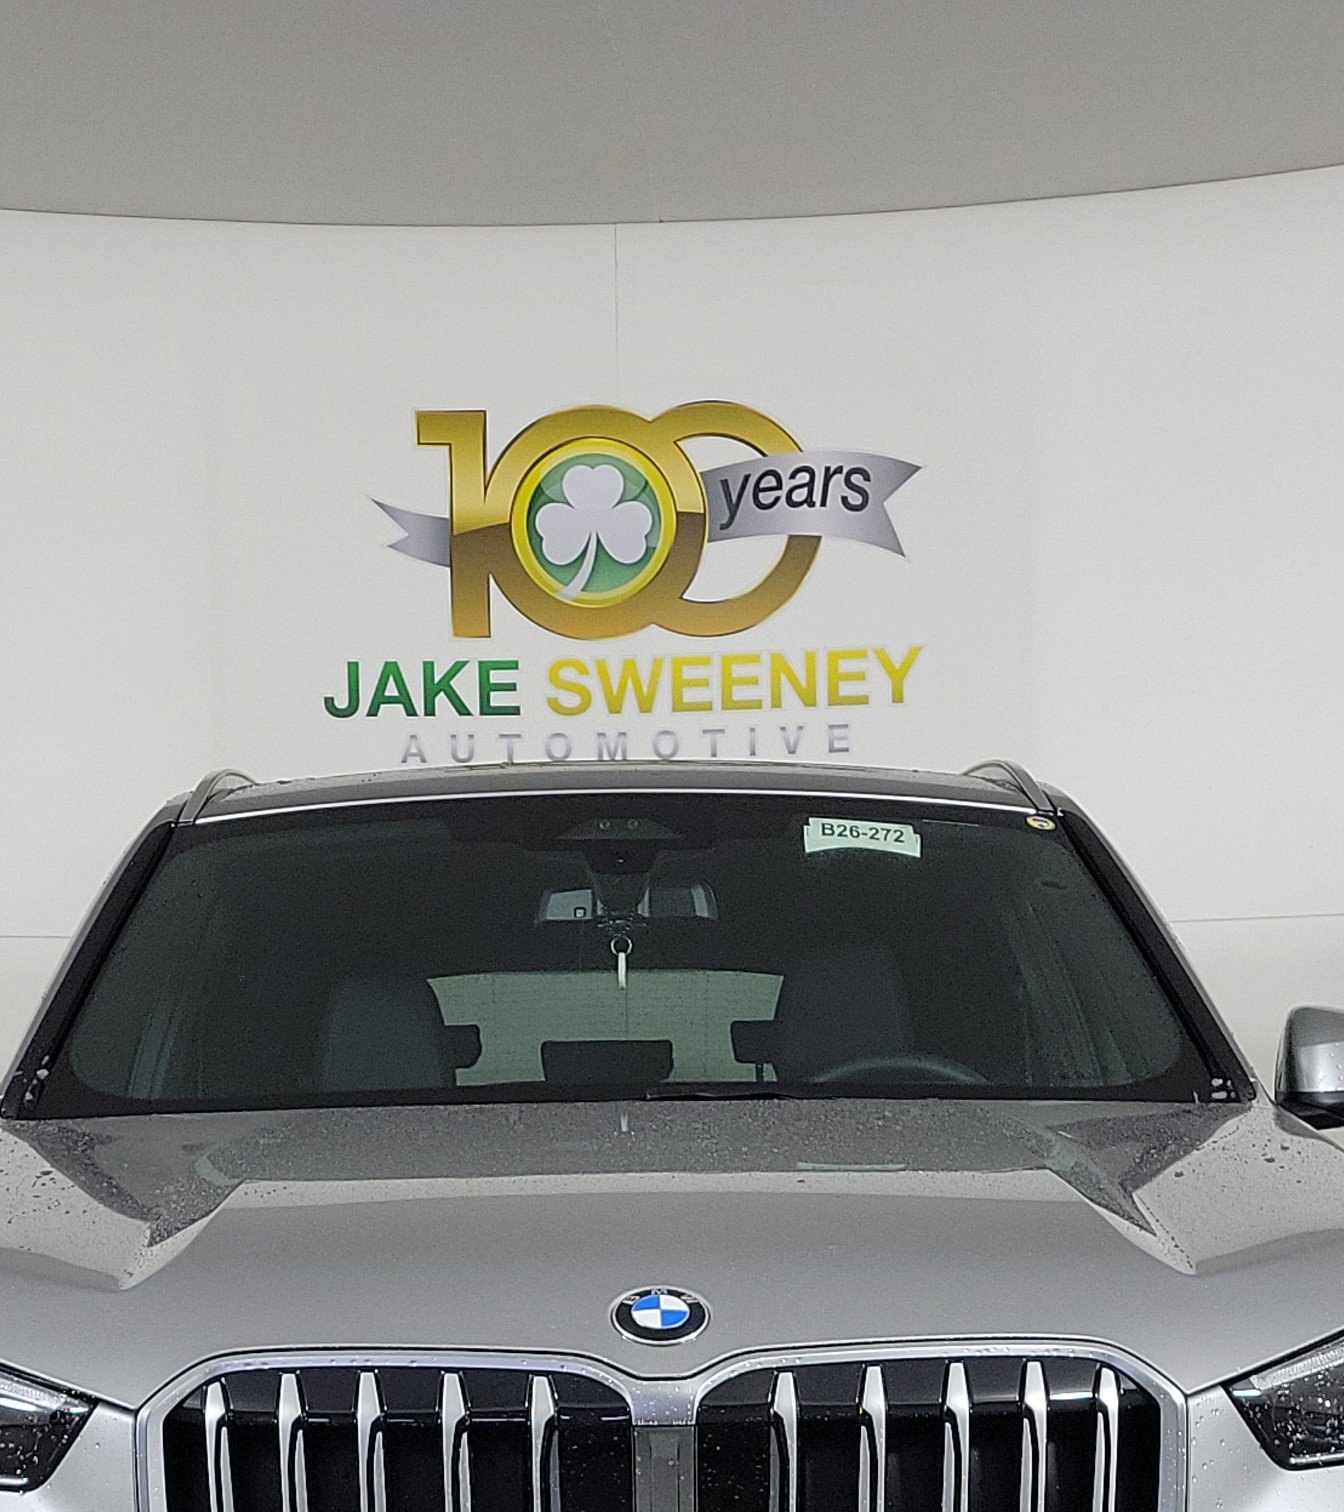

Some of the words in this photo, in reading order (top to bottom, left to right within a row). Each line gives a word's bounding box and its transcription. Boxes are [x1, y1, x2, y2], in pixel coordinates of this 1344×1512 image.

[414, 399, 823, 640] 100
[718, 463, 873, 532] years
[323, 659, 522, 719] JAKE
[546, 645, 924, 716] SWEENEY
[400, 723, 851, 765] AUTOMOTIVE
[820, 822, 906, 844] B26-272
